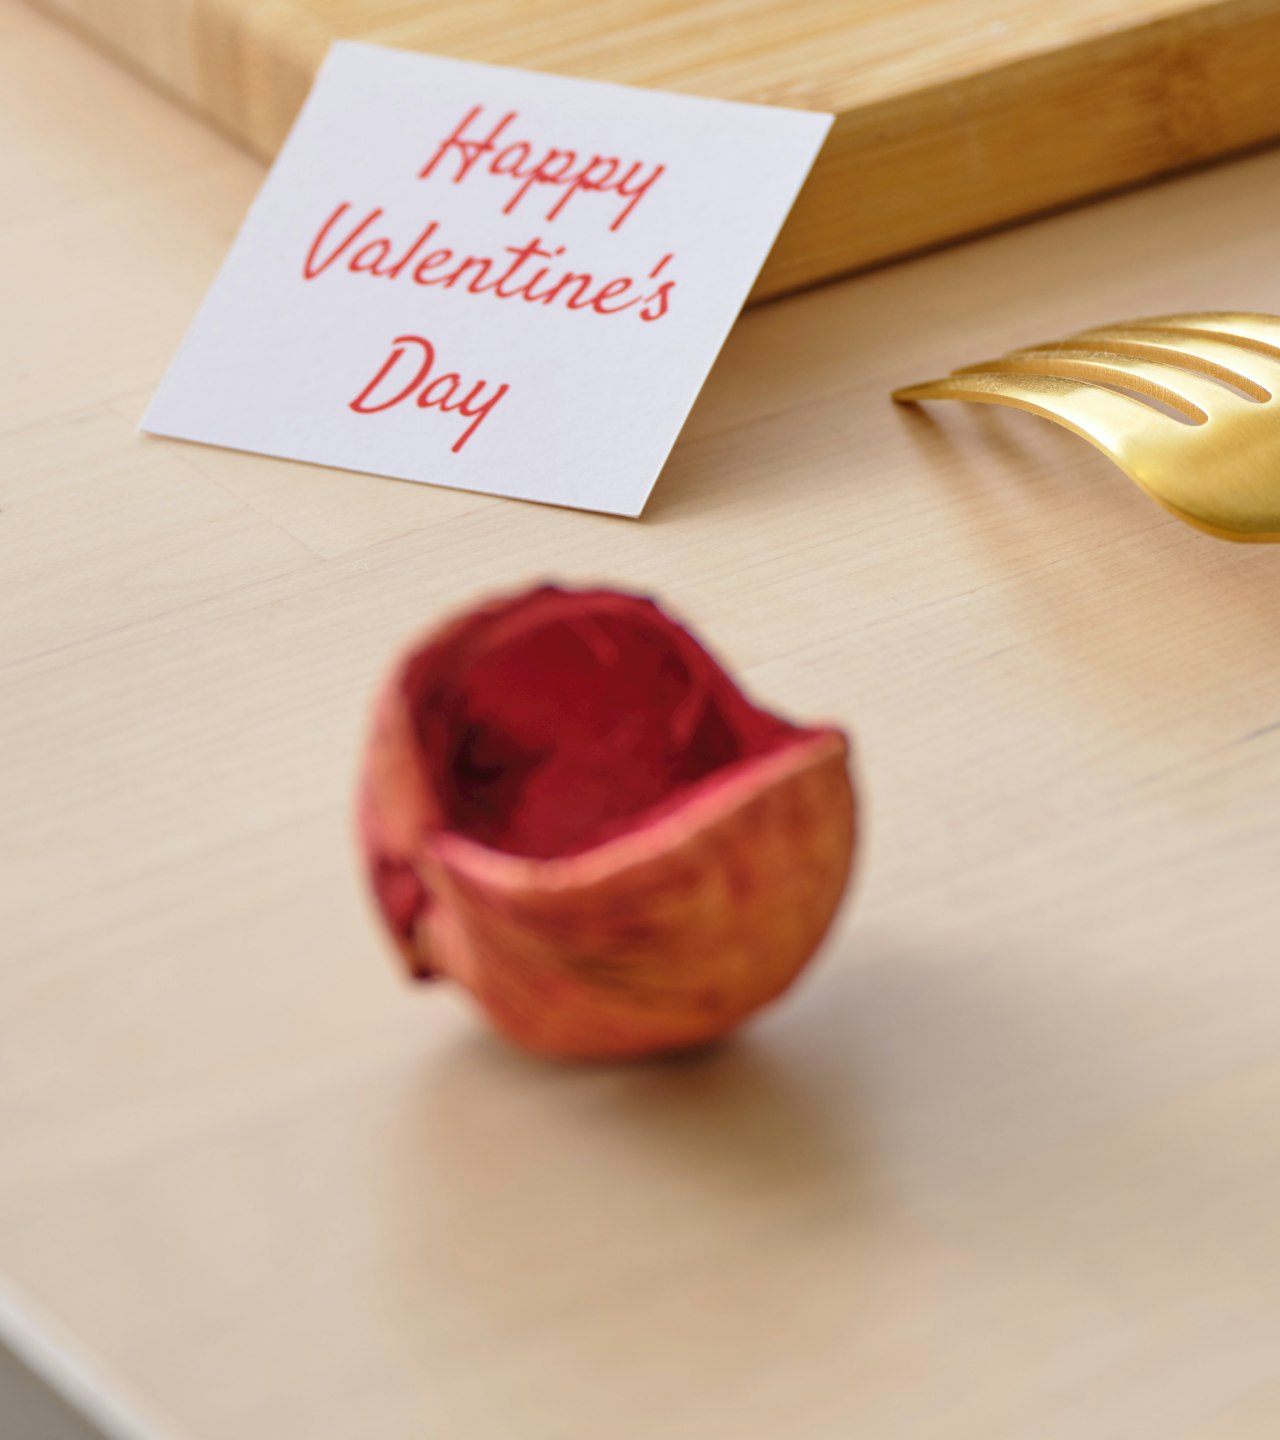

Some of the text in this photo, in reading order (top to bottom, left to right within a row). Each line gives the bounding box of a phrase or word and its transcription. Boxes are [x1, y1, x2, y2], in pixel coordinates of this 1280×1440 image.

[418, 106, 665, 232] Happy
[303, 202, 676, 322] Valentine's
[348, 334, 510, 453] Day
